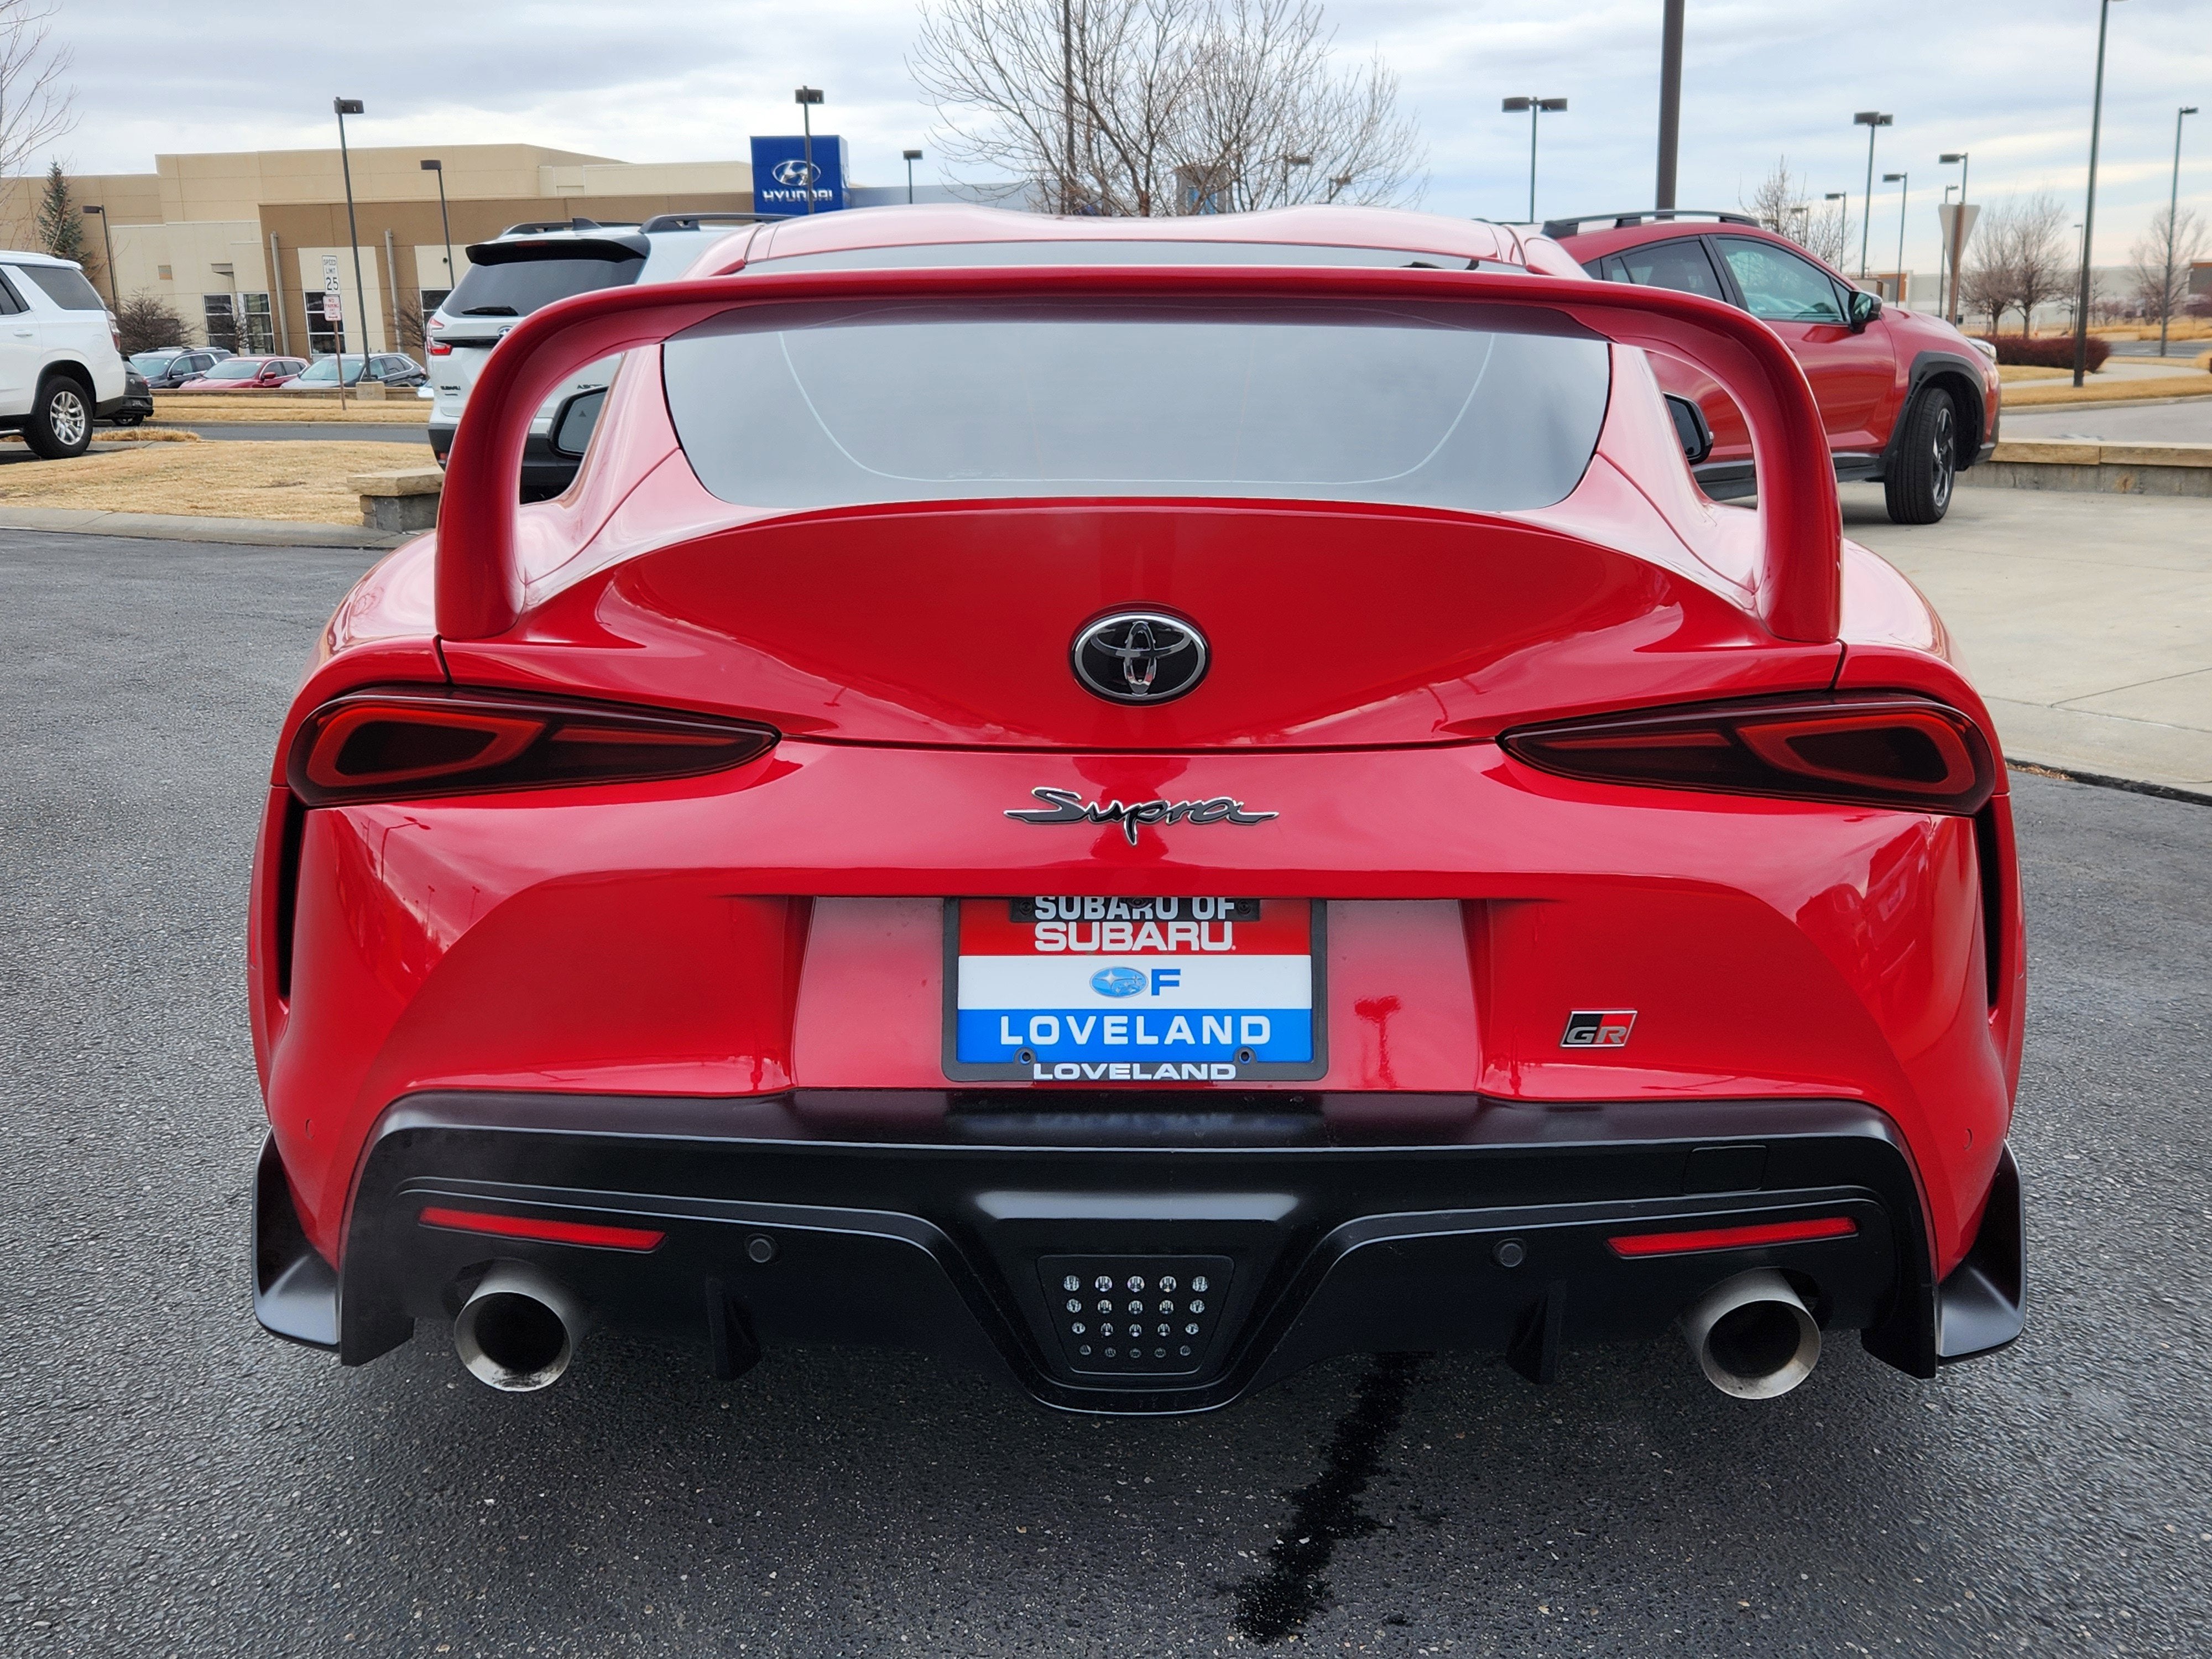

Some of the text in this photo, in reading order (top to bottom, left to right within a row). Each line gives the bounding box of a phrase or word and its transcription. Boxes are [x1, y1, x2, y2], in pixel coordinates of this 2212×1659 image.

[326, 276, 339, 291] 25
[1003, 786, 1280, 847] Supra
[1192, 896, 1235, 920] OF
[1000, 1015, 1271, 1045] LOVELAND
[1566, 1026, 1627, 1044] GR
[1033, 1063, 1237, 1081] LOVELAND
